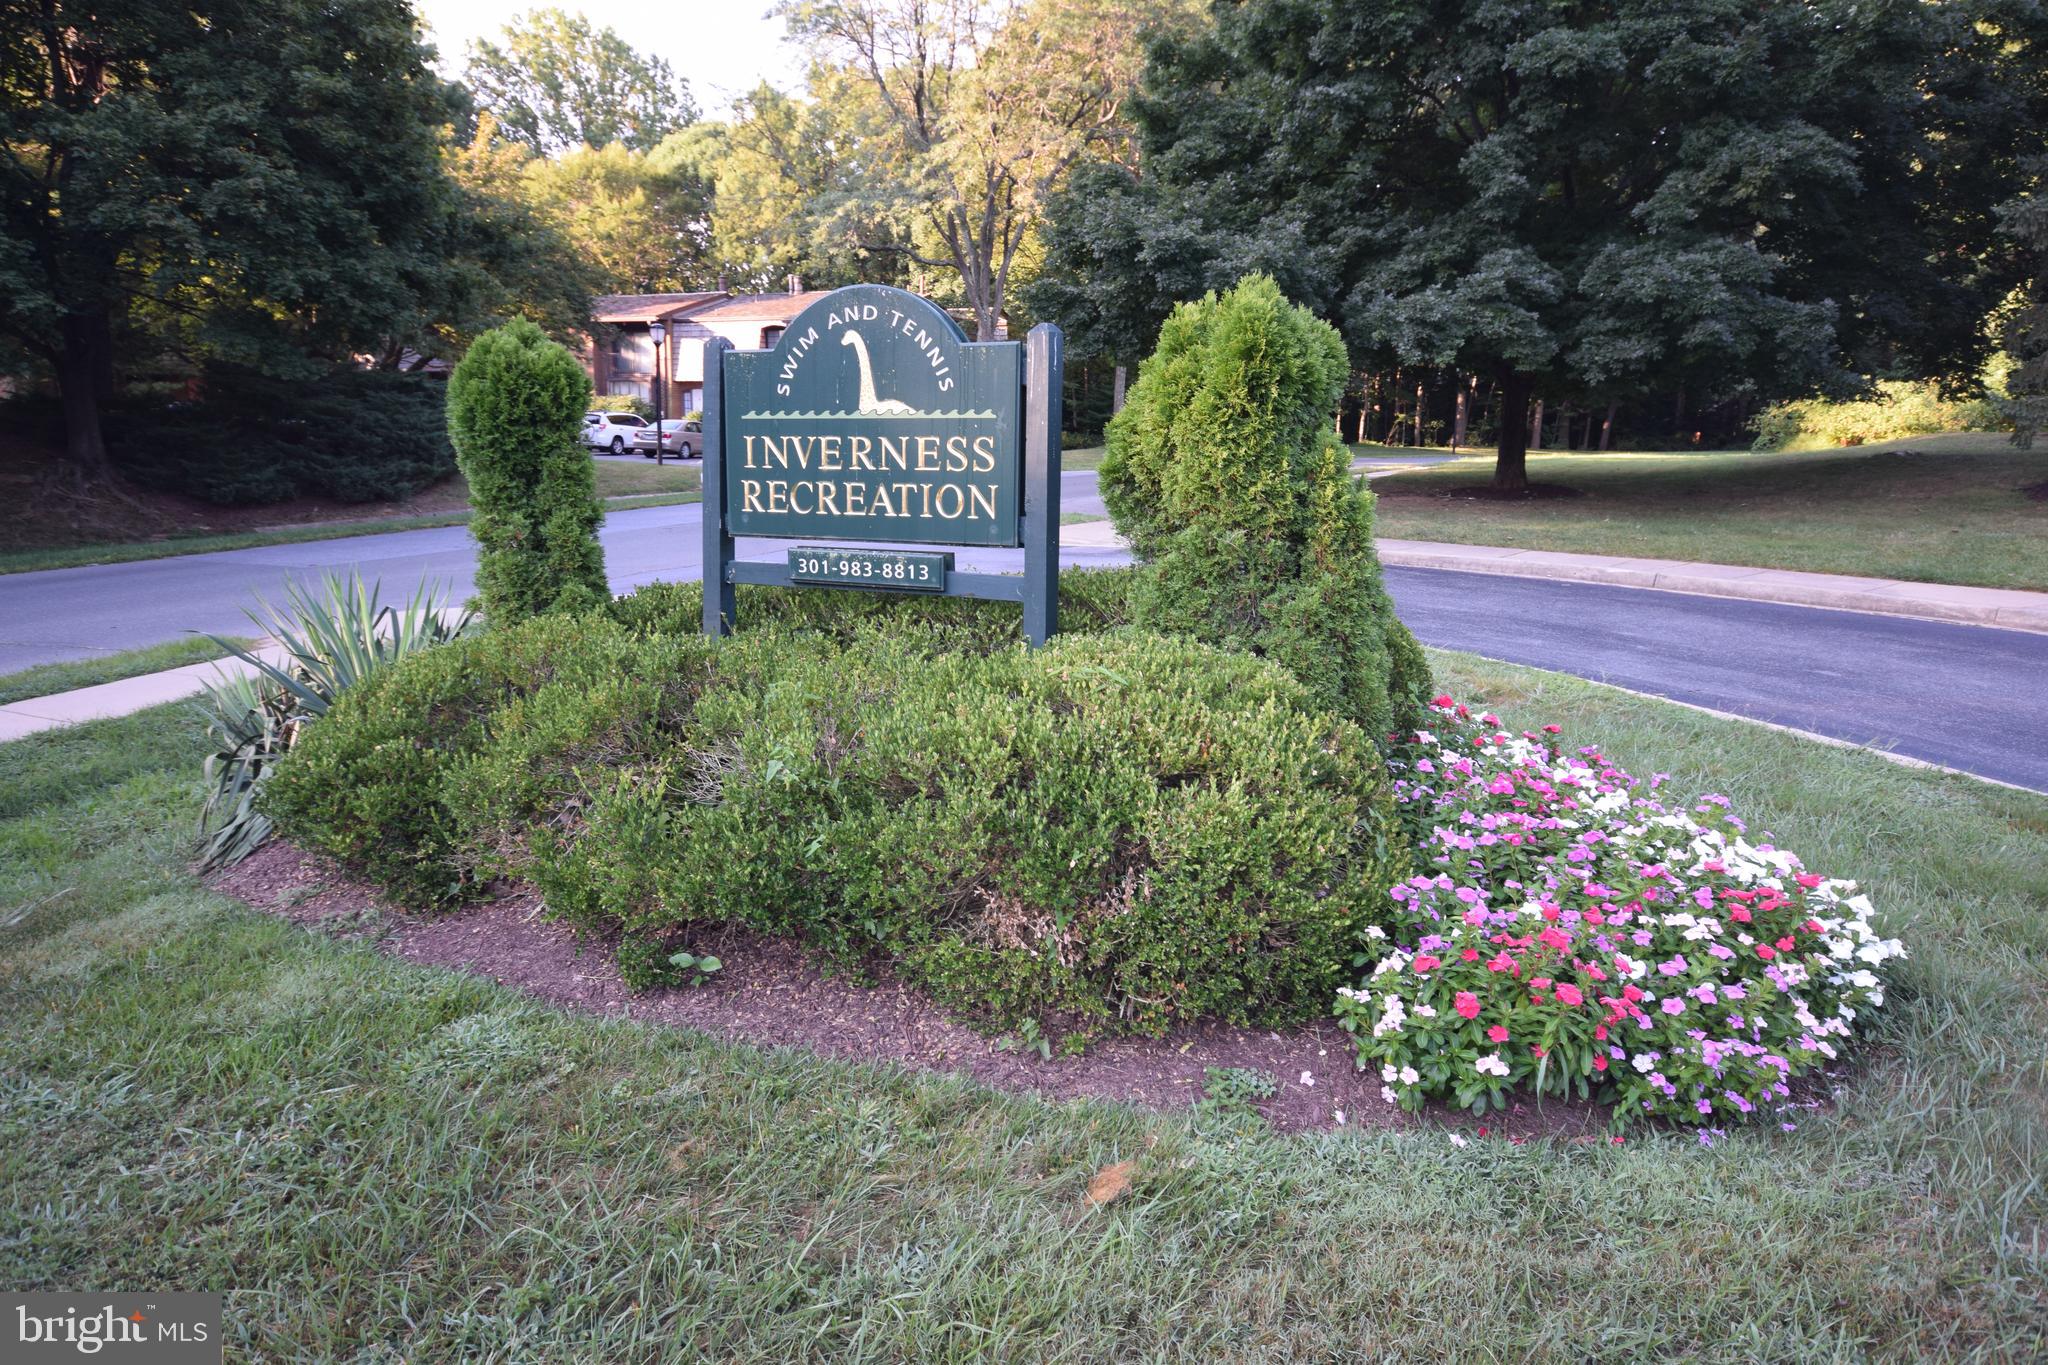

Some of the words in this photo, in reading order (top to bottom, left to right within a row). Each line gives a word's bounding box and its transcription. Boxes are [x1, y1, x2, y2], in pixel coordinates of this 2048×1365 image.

[777, 326, 819, 396] SWIM
[827, 304, 878, 330] AND
[891, 310, 954, 392] TENNIS
[743, 435, 996, 472] INVERNESS
[741, 479, 999, 520] RECREATION
[798, 558, 929, 581] 301-983-8813
